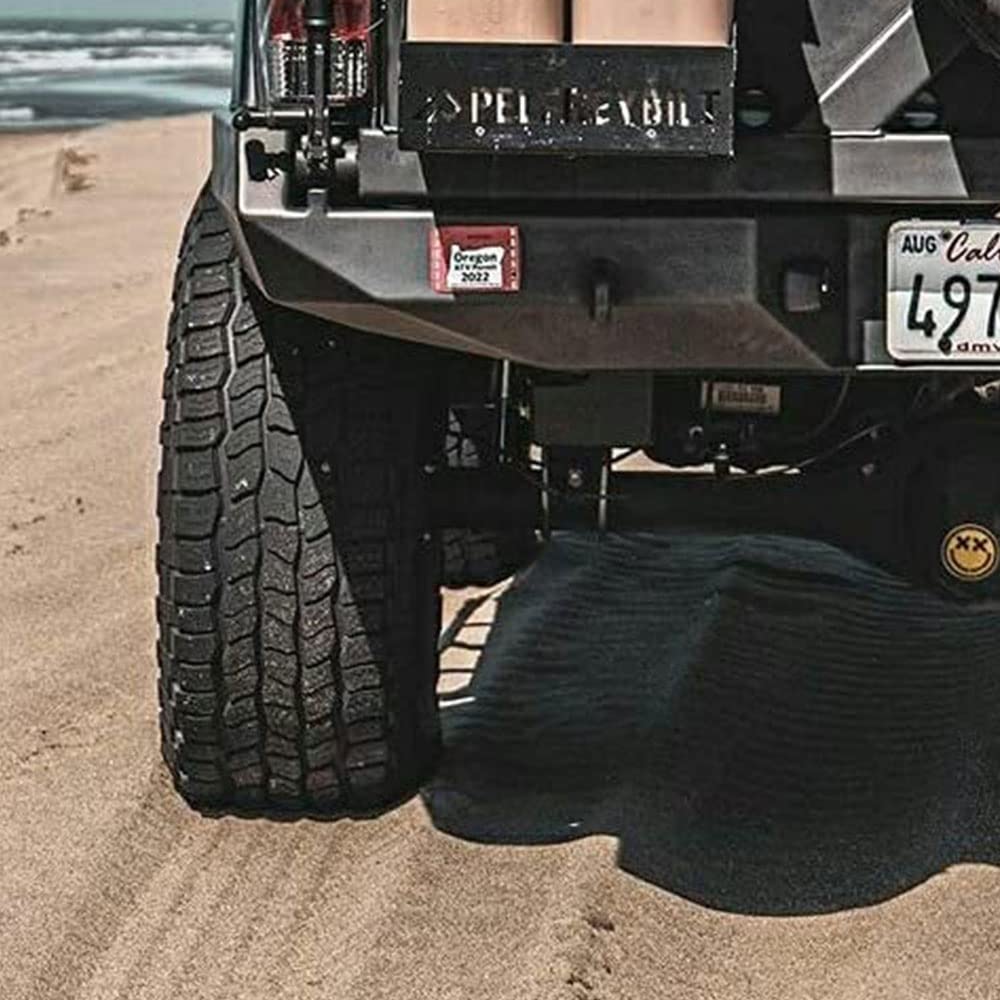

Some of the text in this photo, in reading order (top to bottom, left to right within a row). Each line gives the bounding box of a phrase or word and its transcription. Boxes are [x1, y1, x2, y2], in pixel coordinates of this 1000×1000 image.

[901, 235, 937, 254] AUG
[453, 252, 498, 265] Oregon
[461, 271, 490, 282] 2022
